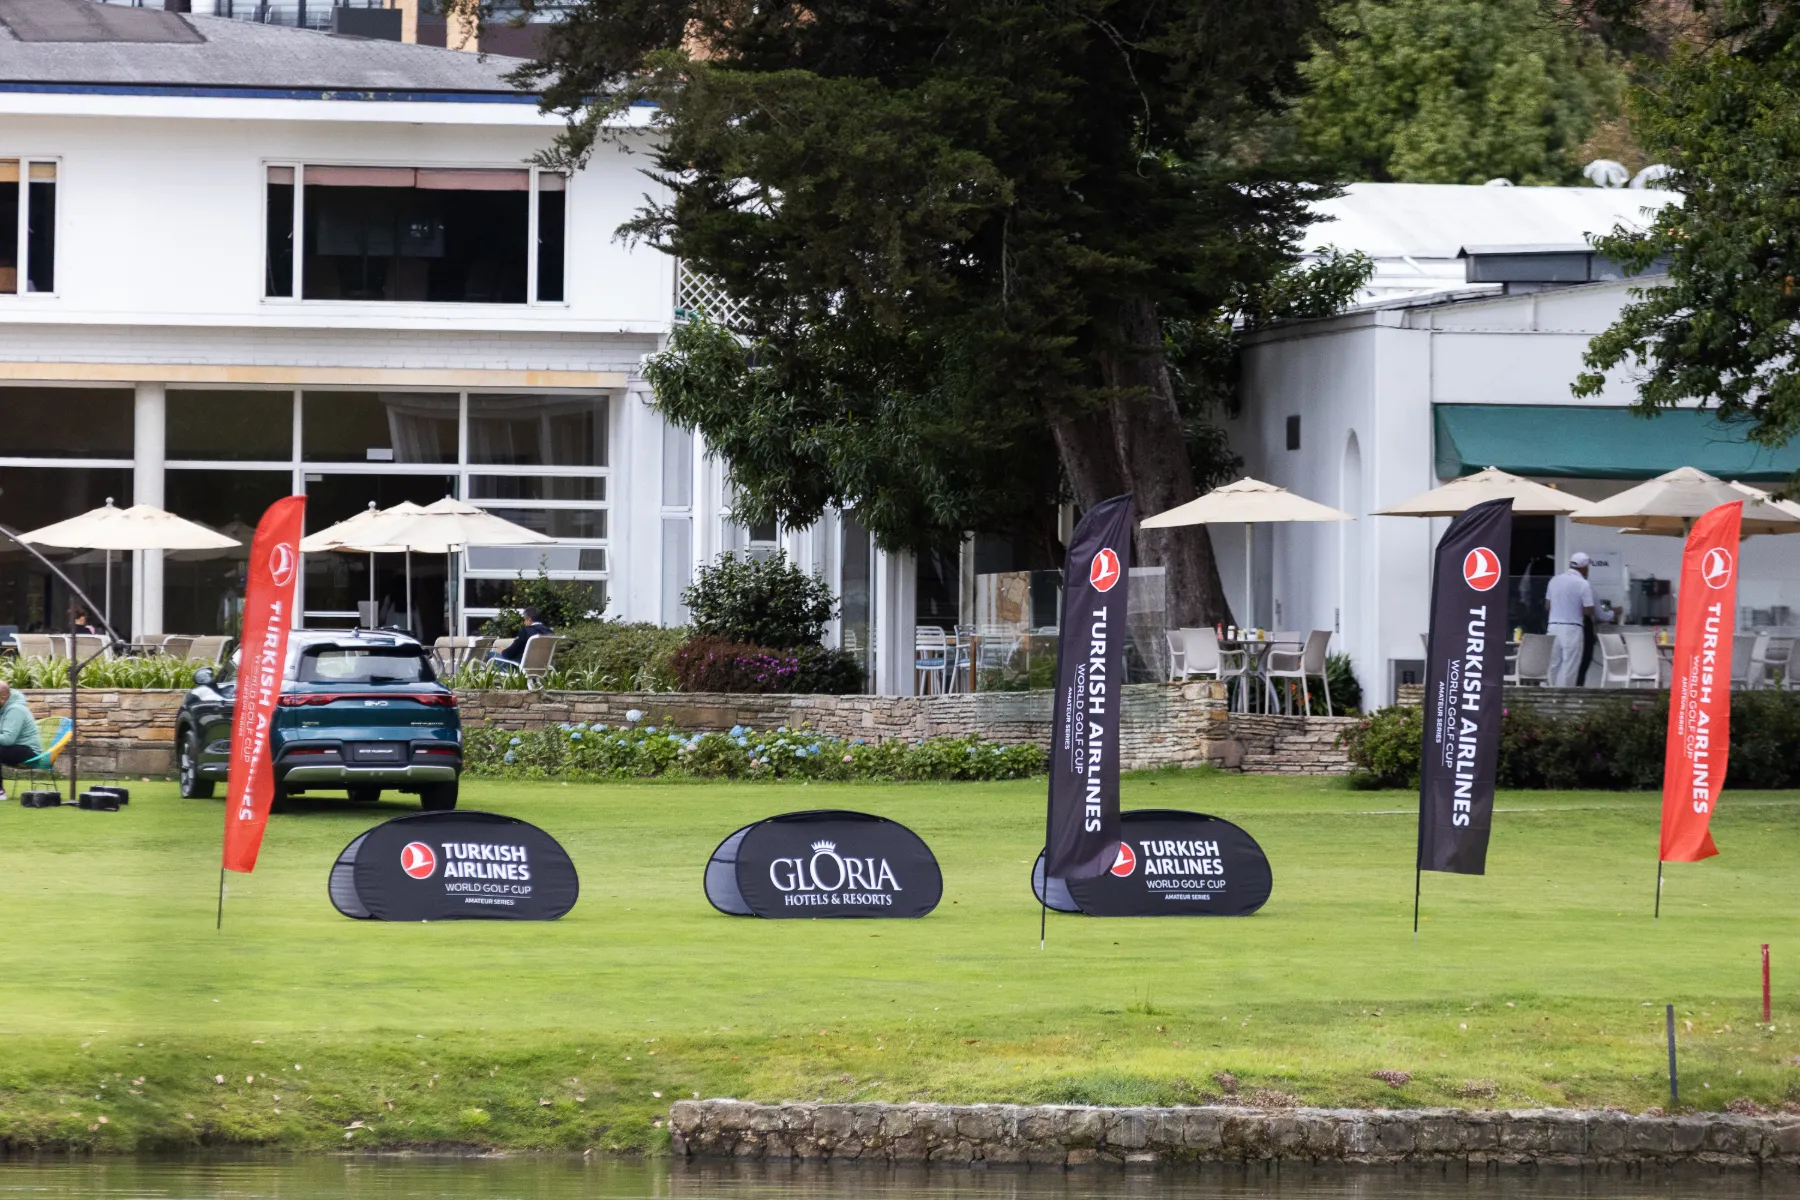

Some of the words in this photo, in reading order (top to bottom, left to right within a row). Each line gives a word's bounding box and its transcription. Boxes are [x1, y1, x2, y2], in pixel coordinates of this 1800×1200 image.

[259, 601, 282, 706] TURKISH
[1089, 606, 1107, 714] TURKISH
[1461, 605, 1486, 711] TURKISH
[1700, 602, 1721, 704] TURKISH
[1076, 664, 1086, 710] WORLD
[1449, 660, 1460, 705] WORLD
[1680, 676, 1688, 711] AMATEUR
[1690, 655, 1700, 698] WORLD
[1437, 681, 1445, 717] AMATEUR
[245, 701, 255, 737] GOLF
[1075, 712, 1084, 746] GOLF
[1435, 718, 1443, 744] SERIES
[1446, 707, 1457, 741] GOLF
[1688, 701, 1697, 732] GOLF
[1074, 748, 1084, 774] CUP
[1445, 743, 1454, 768] CUP
[1686, 735, 1695, 759] CUP
[1692, 709, 1710, 813] AIRLINES
[1085, 721, 1104, 832] AIRLINES
[1452, 717, 1478, 826] AIRLINES
[441, 843, 527, 862] TURKISH
[1139, 841, 1219, 856] TURKISH
[444, 862, 530, 880] AIRLINES
[769, 851, 902, 891] GLORIA
[1145, 859, 1224, 875] AIRLINES
[1146, 879, 1180, 889] WORLD
[1181, 879, 1205, 889] GOLF
[1207, 879, 1226, 889] CUP
[445, 883, 482, 892] WORLD
[483, 883, 509, 893] GOLF
[511, 885, 531, 895] CUP
[465, 897, 493, 905] AMATEUR
[494, 898, 514, 906] SERIES
[784, 893, 829, 906] HOTELS
[831, 894, 840, 905] &
[842, 893, 892, 906] RESORTS
[1165, 893, 1191, 901] AMATEUR
[1191, 893, 1210, 901] SERIES
